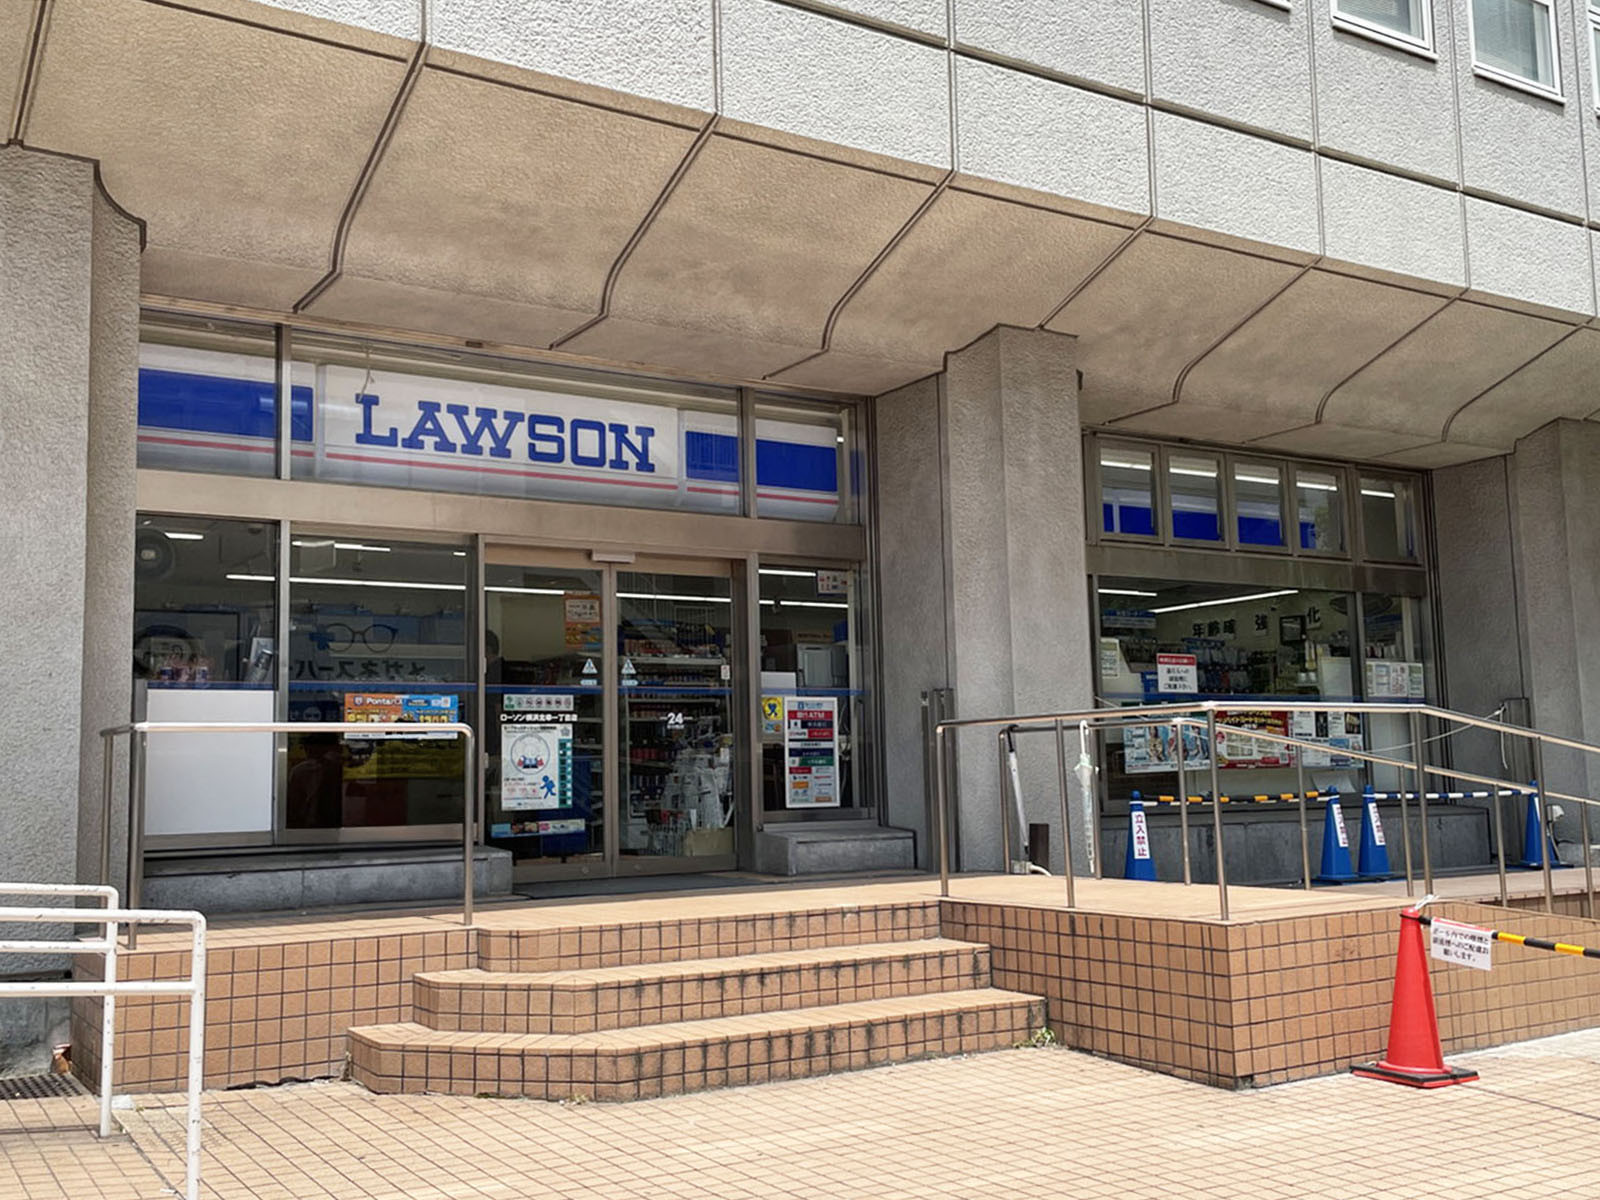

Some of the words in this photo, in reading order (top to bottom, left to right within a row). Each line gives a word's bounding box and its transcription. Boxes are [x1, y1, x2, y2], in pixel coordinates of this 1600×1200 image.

[355, 393, 655, 473] LAWSON
[667, 712, 684, 724] 24
[1135, 813, 1147, 857] 立入禁止
